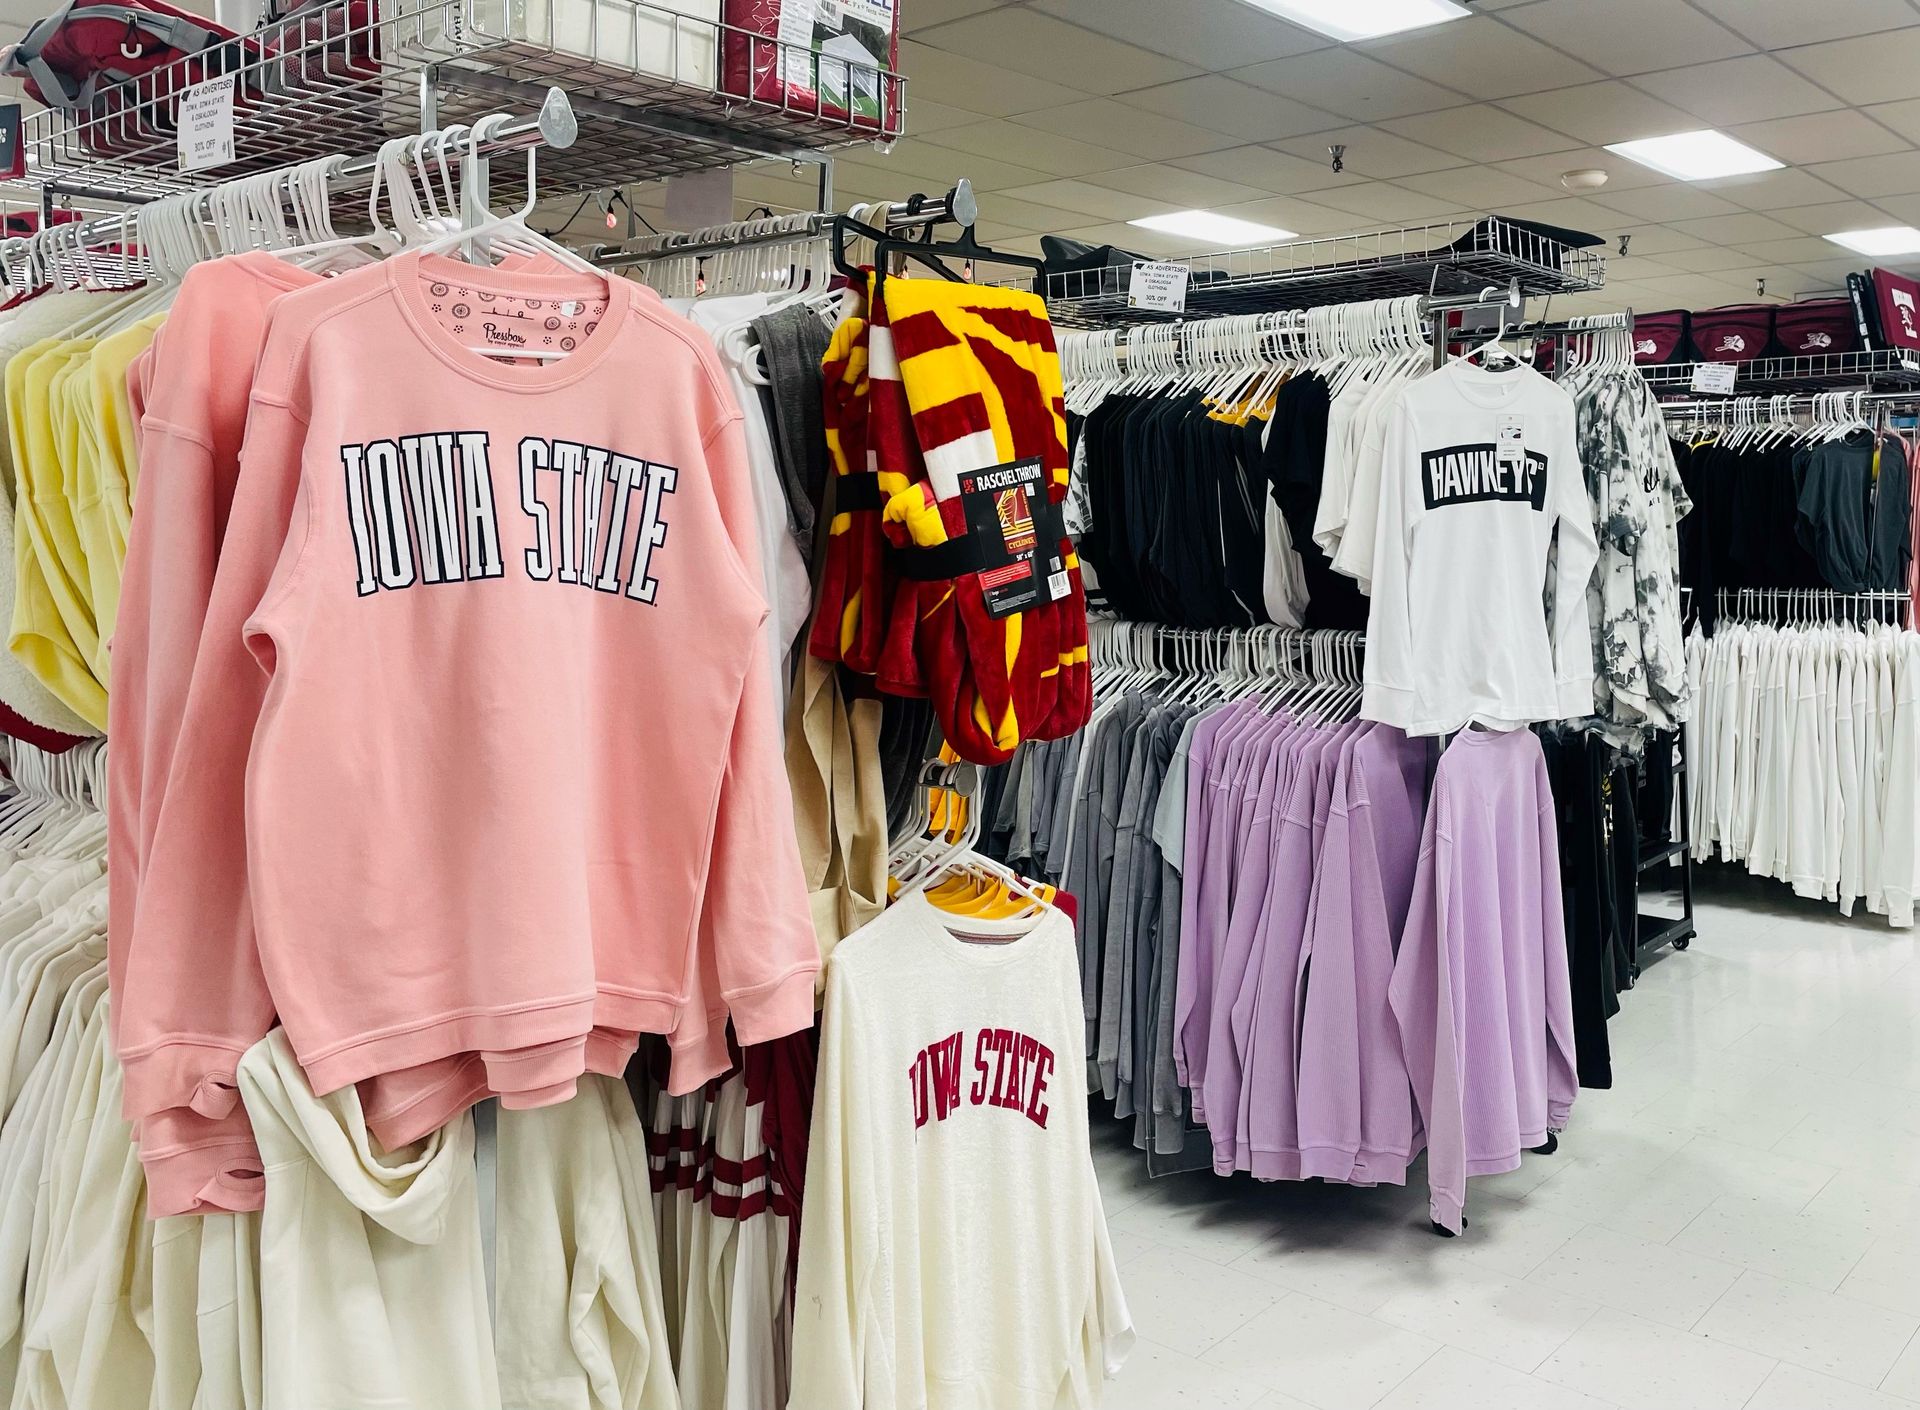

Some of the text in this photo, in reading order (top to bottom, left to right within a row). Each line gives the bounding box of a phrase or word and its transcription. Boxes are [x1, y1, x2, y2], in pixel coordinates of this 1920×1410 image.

[193, 79, 233, 97] AS ADVERTISED
[211, 95, 225, 106] STATE
[206, 139, 216, 150] OFF
[1155, 265, 1188, 273] ADVERTISED
[483, 322, 527, 344] Pressbox
[977, 468, 1018, 492] RASCHEL
[1015, 463, 1042, 483] THROW
[340, 430, 679, 606] IOWA STATE
[969, 1028, 1055, 1130] STATE
